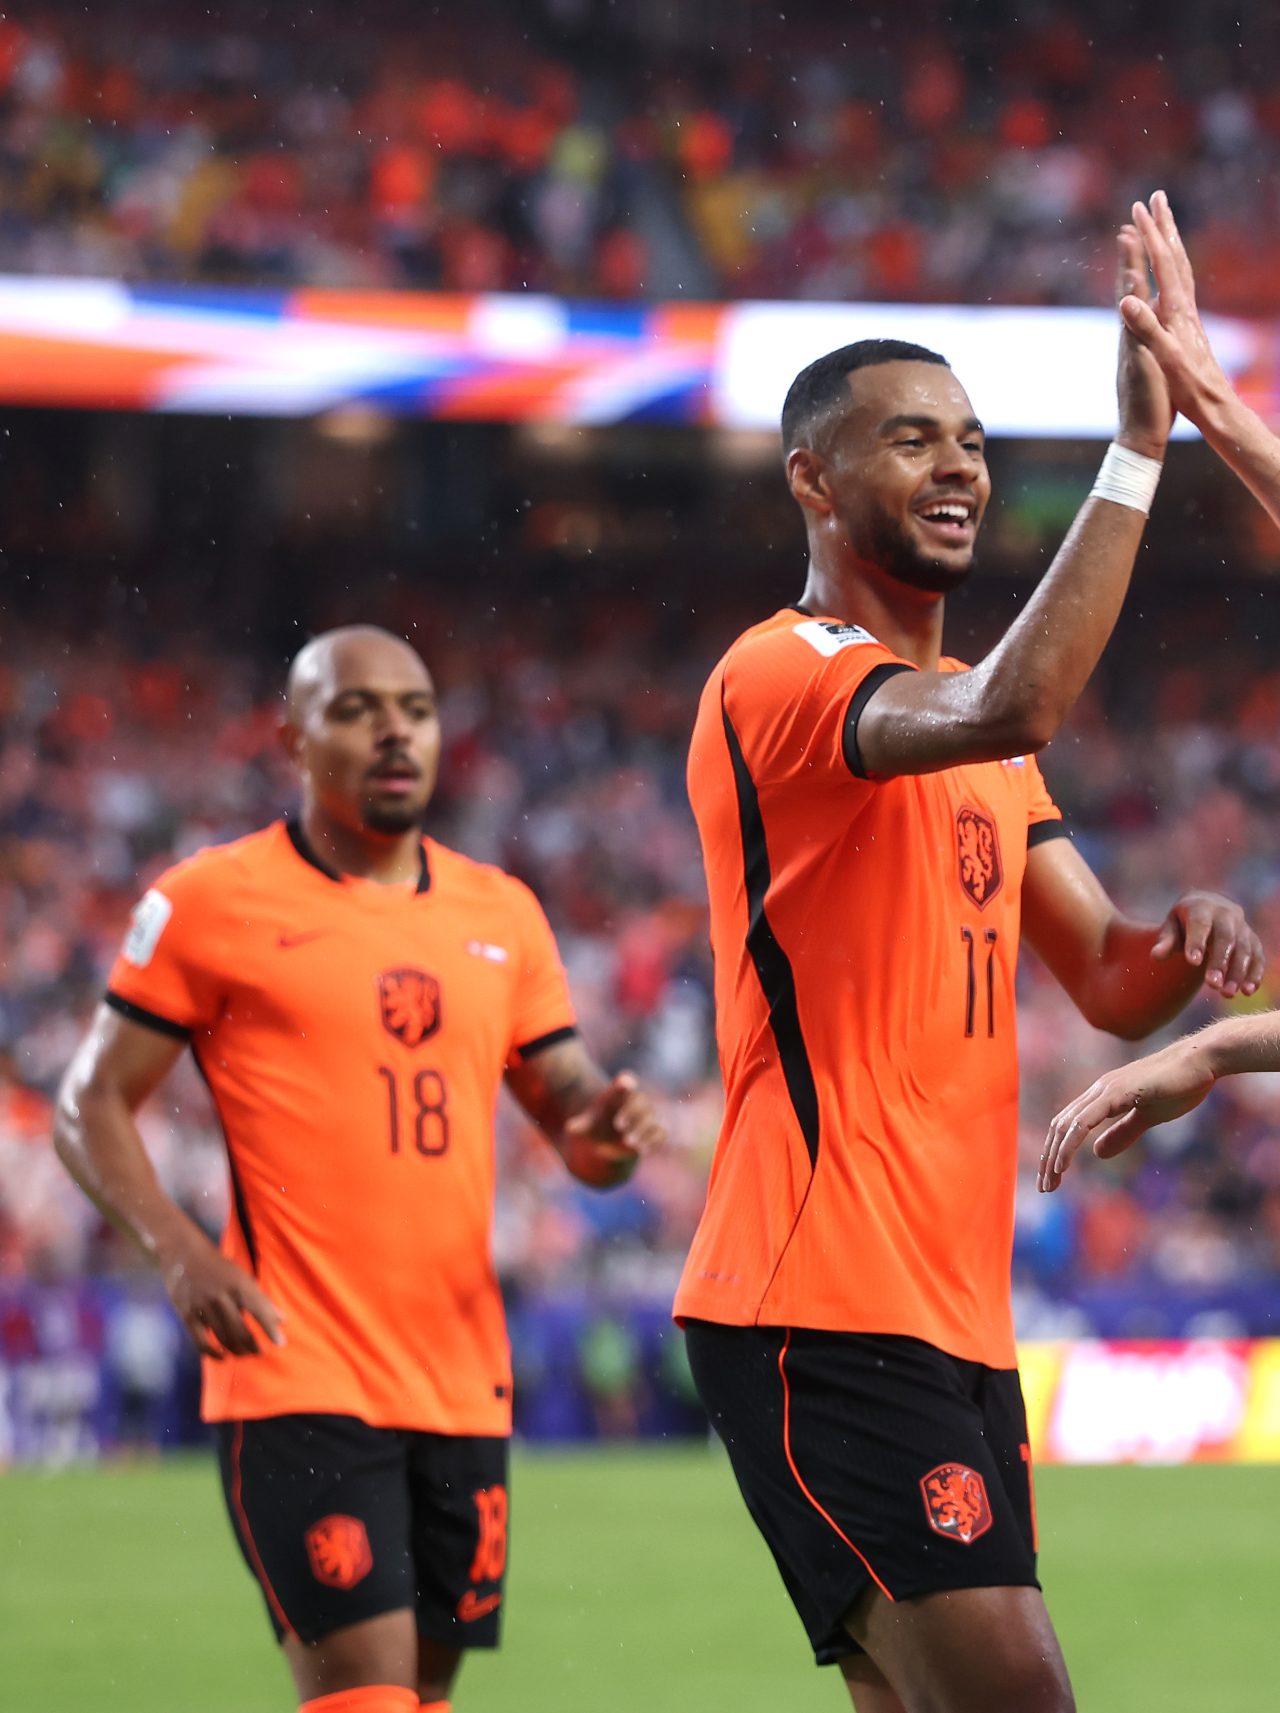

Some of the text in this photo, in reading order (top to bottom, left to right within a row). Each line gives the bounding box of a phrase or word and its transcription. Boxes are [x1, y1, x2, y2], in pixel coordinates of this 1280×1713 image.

[961, 926, 998, 1038] 11
[378, 1066, 450, 1157] 18
[468, 1483, 509, 1584] 18
